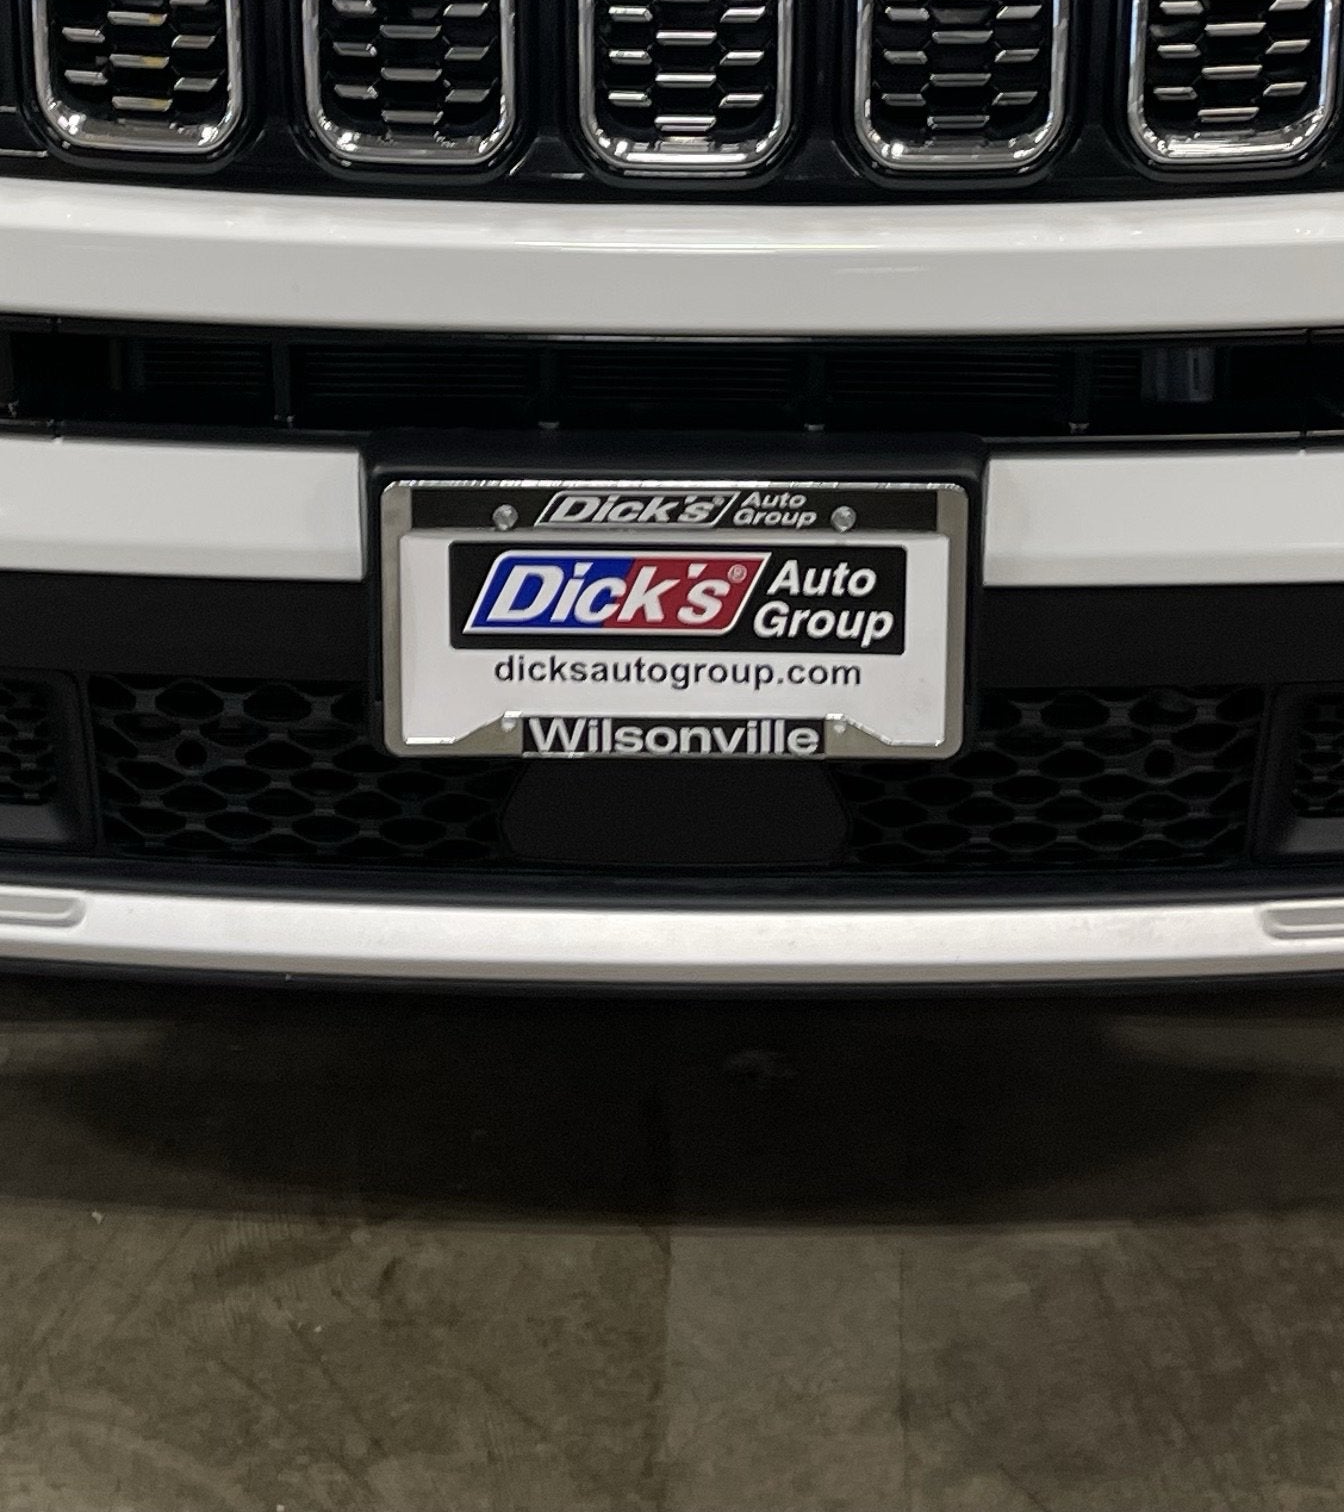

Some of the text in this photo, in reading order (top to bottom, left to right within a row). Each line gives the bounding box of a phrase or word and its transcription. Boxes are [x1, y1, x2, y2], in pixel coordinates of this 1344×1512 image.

[549, 494, 716, 522] Dick's
[733, 508, 817, 529] Group
[741, 492, 806, 509] Auto
[486, 562, 731, 623] Dick's
[766, 559, 877, 597] Auto
[753, 600, 895, 648] Group
[494, 655, 862, 691] dicksautogroup.com
[528, 718, 821, 755] Wilsonville
